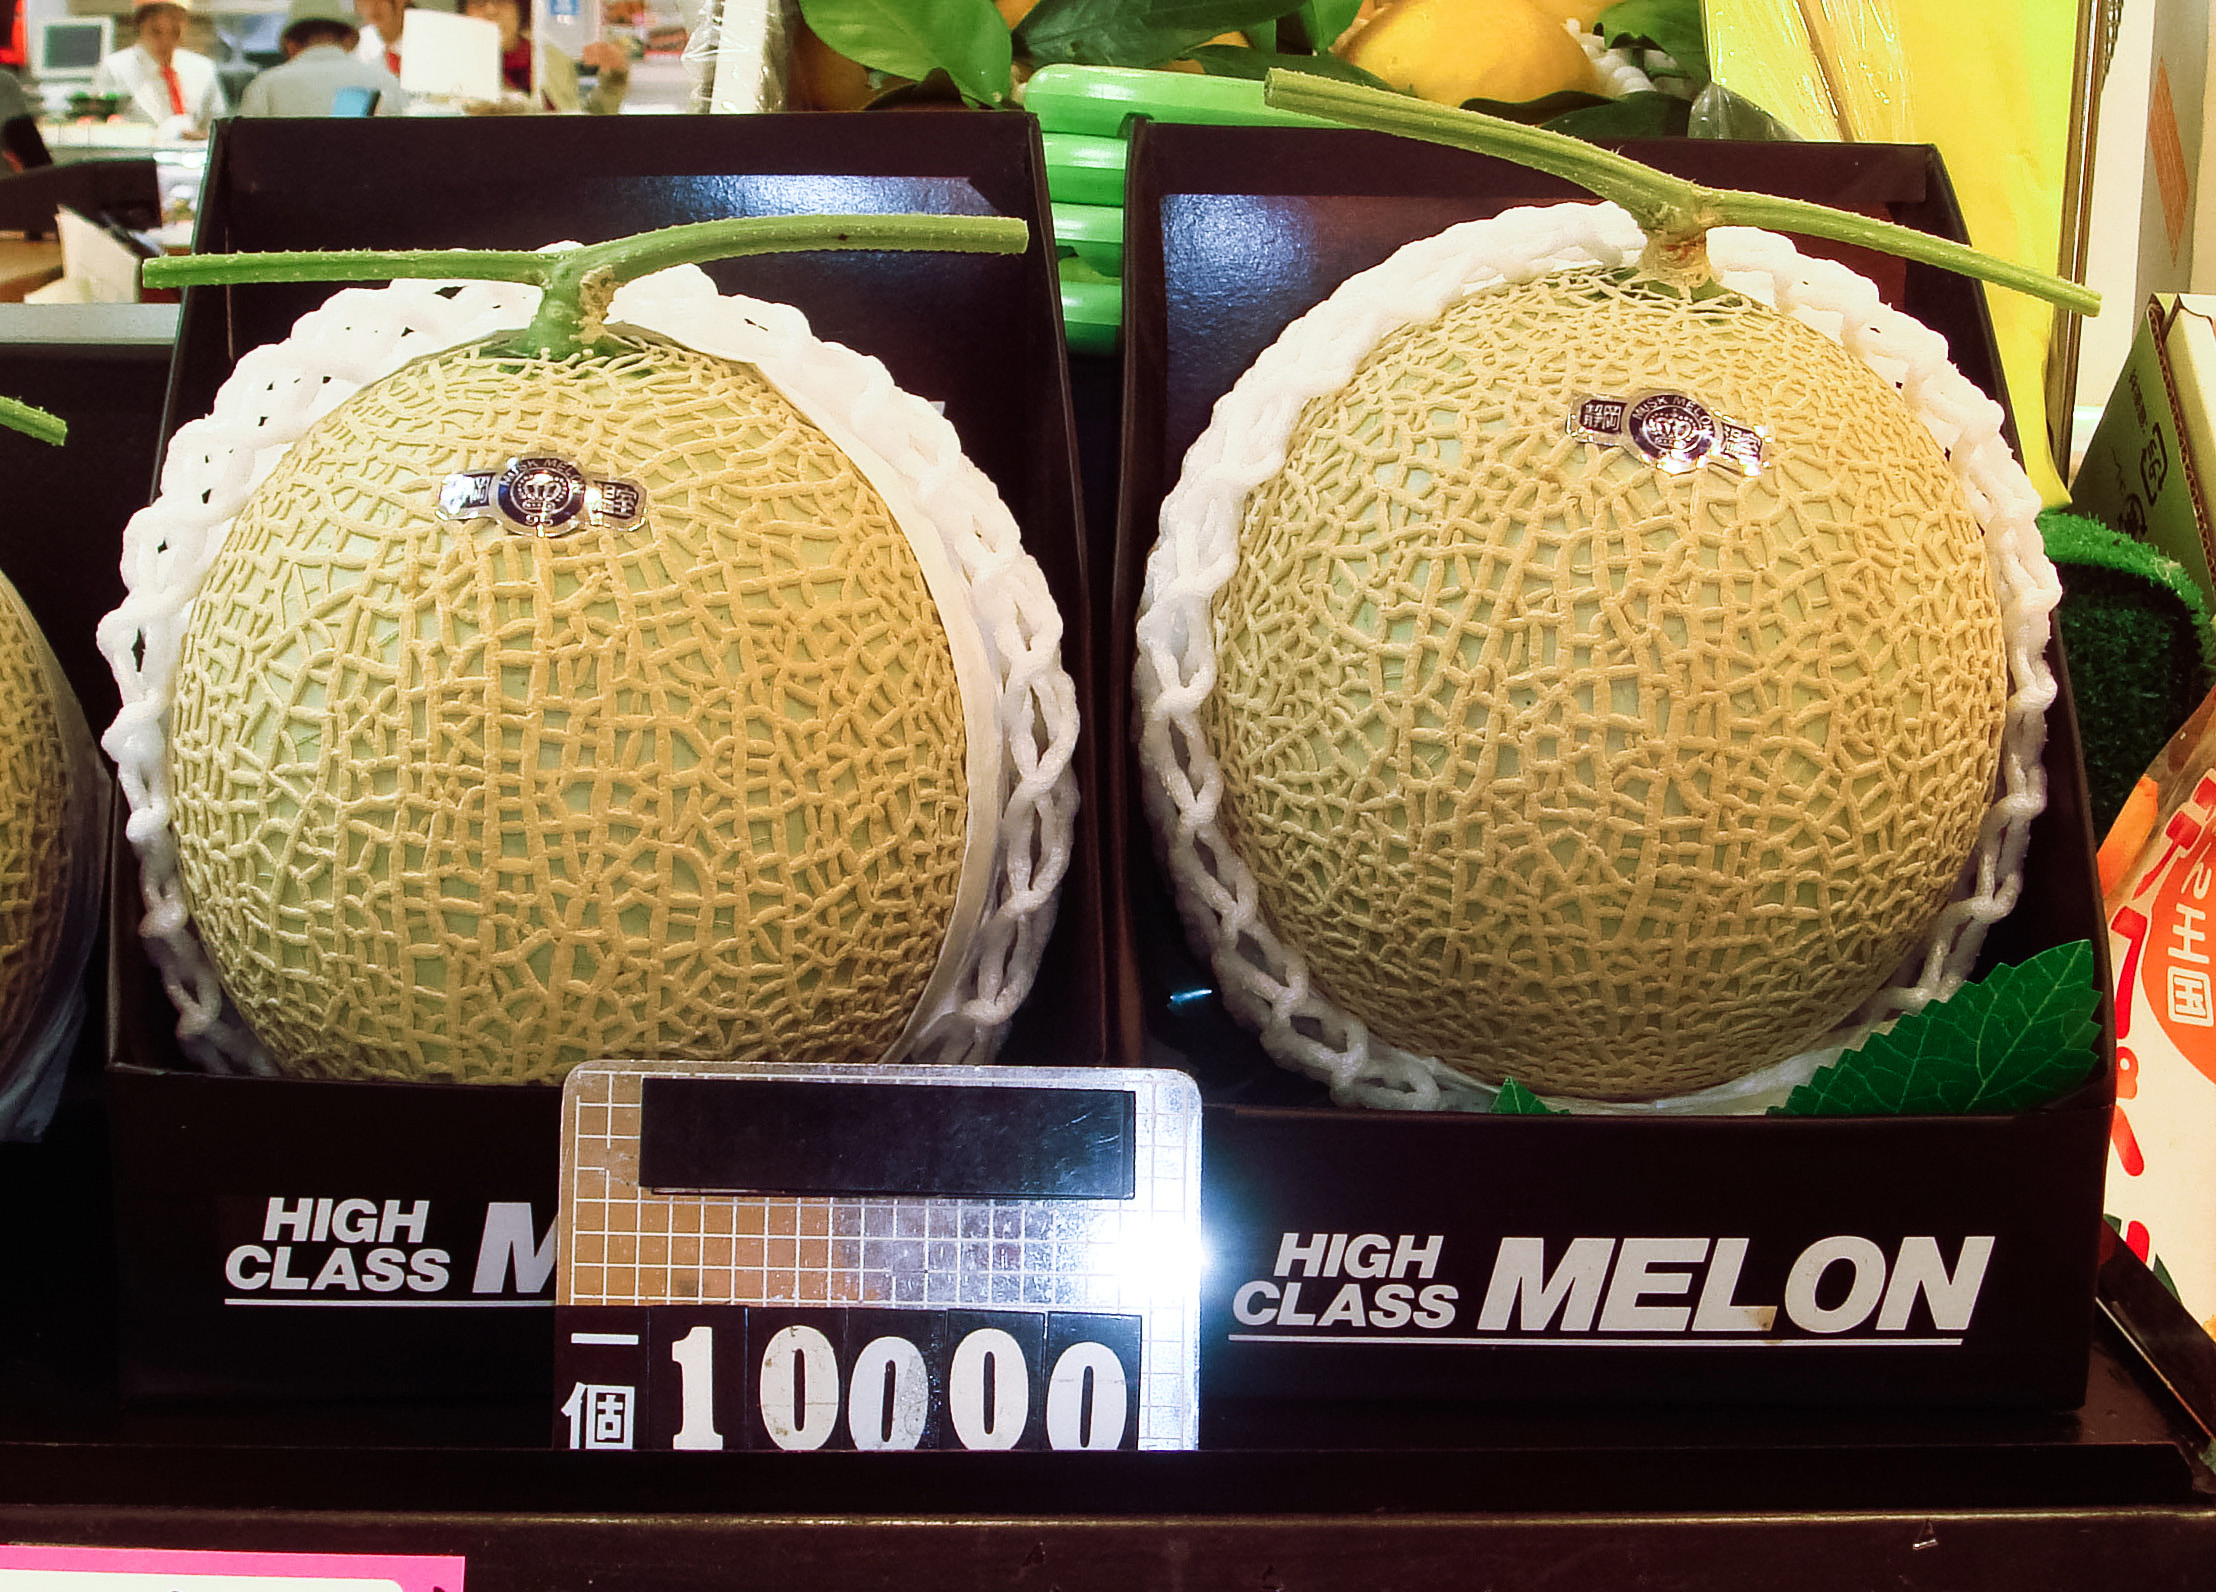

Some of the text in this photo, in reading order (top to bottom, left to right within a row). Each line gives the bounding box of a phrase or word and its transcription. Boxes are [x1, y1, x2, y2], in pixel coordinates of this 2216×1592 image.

[1632, 397, 1670, 421] MUSK
[2167, 840, 2216, 1028] ん王国
[225, 1202, 559, 1294] CLASS M
[262, 1197, 430, 1243] HIGH
[1274, 1231, 1444, 1279] HIGH
[1231, 1236, 1996, 1334] CLASS MELON
[671, 1324, 1128, 1451] 10000
